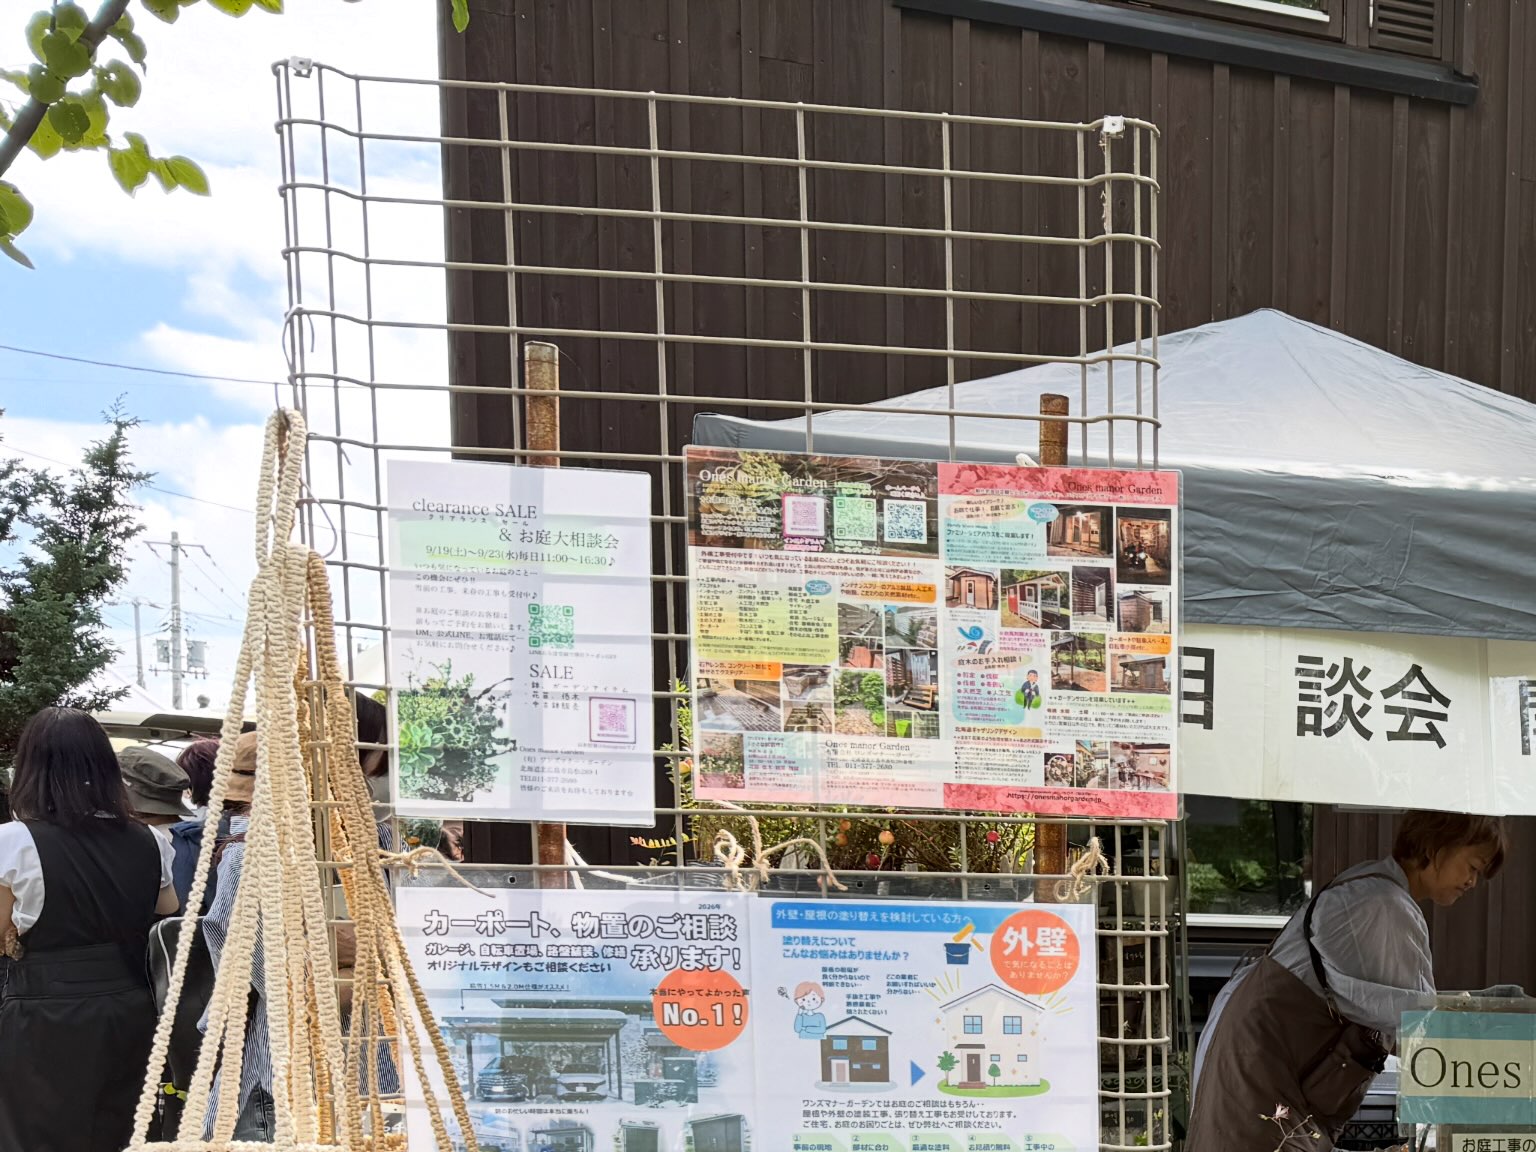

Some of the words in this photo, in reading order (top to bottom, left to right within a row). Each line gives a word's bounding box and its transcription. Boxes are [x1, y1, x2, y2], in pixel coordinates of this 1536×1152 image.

[699, 469, 734, 482] Ones
[781, 473, 828, 489] Garden
[1095, 483, 1124, 493] manor
[1128, 484, 1163, 495] Garden
[412, 498, 489, 516] clearance
[495, 503, 537, 519] SALE
[519, 530, 620, 549] お庭大相談会
[529, 664, 574, 679] SALE
[879, 742, 910, 751] Garden
[776, 909, 973, 925] 外壁・屋根の塗り替えを検討している方へ
[423, 909, 738, 941] カーポート、物置のご相談
[782, 936, 856, 947] 塗り替えについて
[1002, 926, 1068, 957] 外壁
[782, 949, 909, 961] こんなお悩みはありませんか？
[427, 960, 612, 973] オリジナルデザインもご相談ください
[1004, 960, 1073, 970] で気になることは
[1009, 971, 1068, 980] ありませんか？
[649, 988, 750, 997] 本当にやってよかった声
[1410, 1046, 1522, 1089] Ones
[803, 1120, 1002, 1129] ご住宅、お庭のお困りごとは、ぜひ弊社へご相談ください。
[1025, 1143, 1055, 1151] 工事中の
